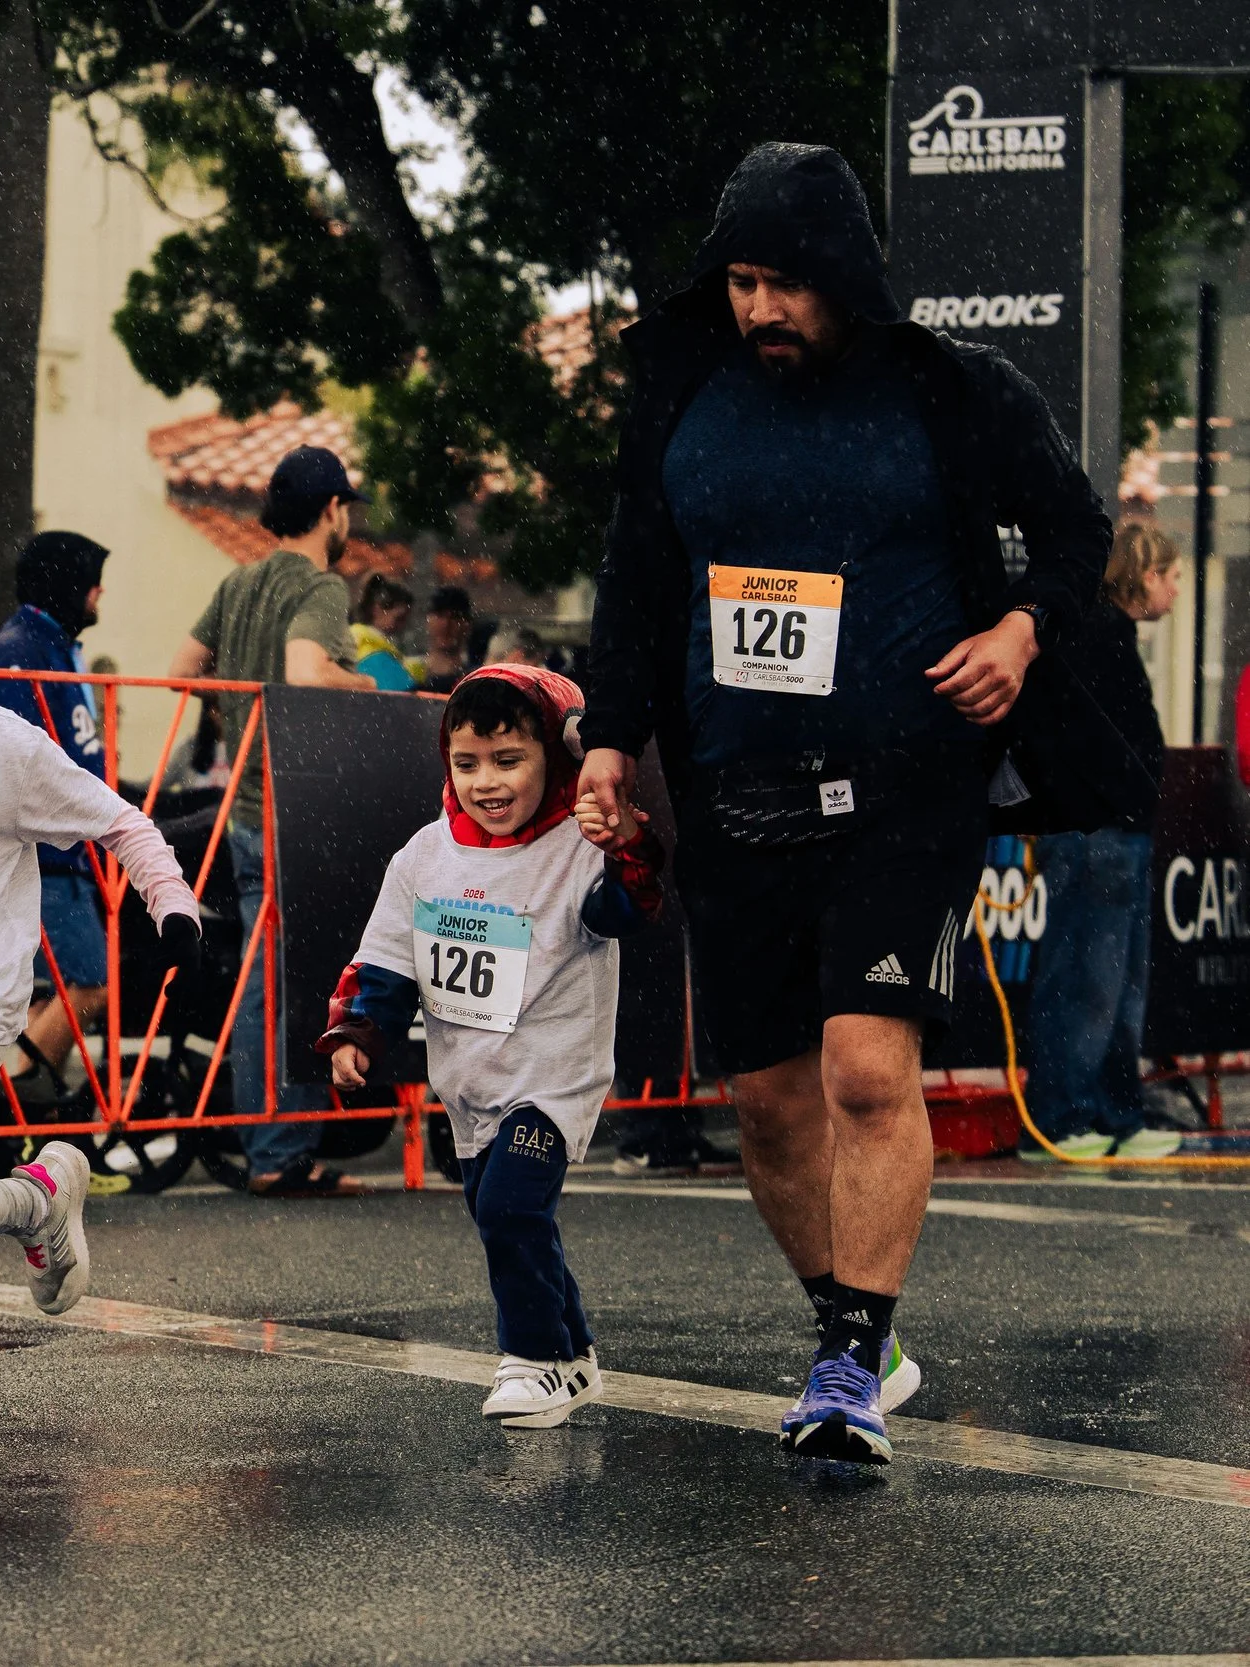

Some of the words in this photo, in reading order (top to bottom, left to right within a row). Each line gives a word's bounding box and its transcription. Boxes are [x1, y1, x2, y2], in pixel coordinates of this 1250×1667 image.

[908, 125, 1067, 156] CARLSBAD
[947, 152, 1066, 173] CALIFORNIA
[909, 293, 1065, 328] BROOKS
[741, 576, 799, 592] JUNIOR
[741, 591, 797, 603] CARLSBAD
[733, 607, 807, 660] 126
[741, 661, 789, 672] COMPANION
[827, 801, 848, 809] adidas
[463, 888, 486, 900] 2026
[963, 867, 1048, 941] 000
[437, 913, 489, 933] JUNIOR
[437, 927, 487, 943] CARLSBAD
[430, 941, 497, 998] 126
[865, 971, 910, 985] adidas
[513, 1125, 555, 1152] GAP
[507, 1145, 550, 1163] ORIGINAL
